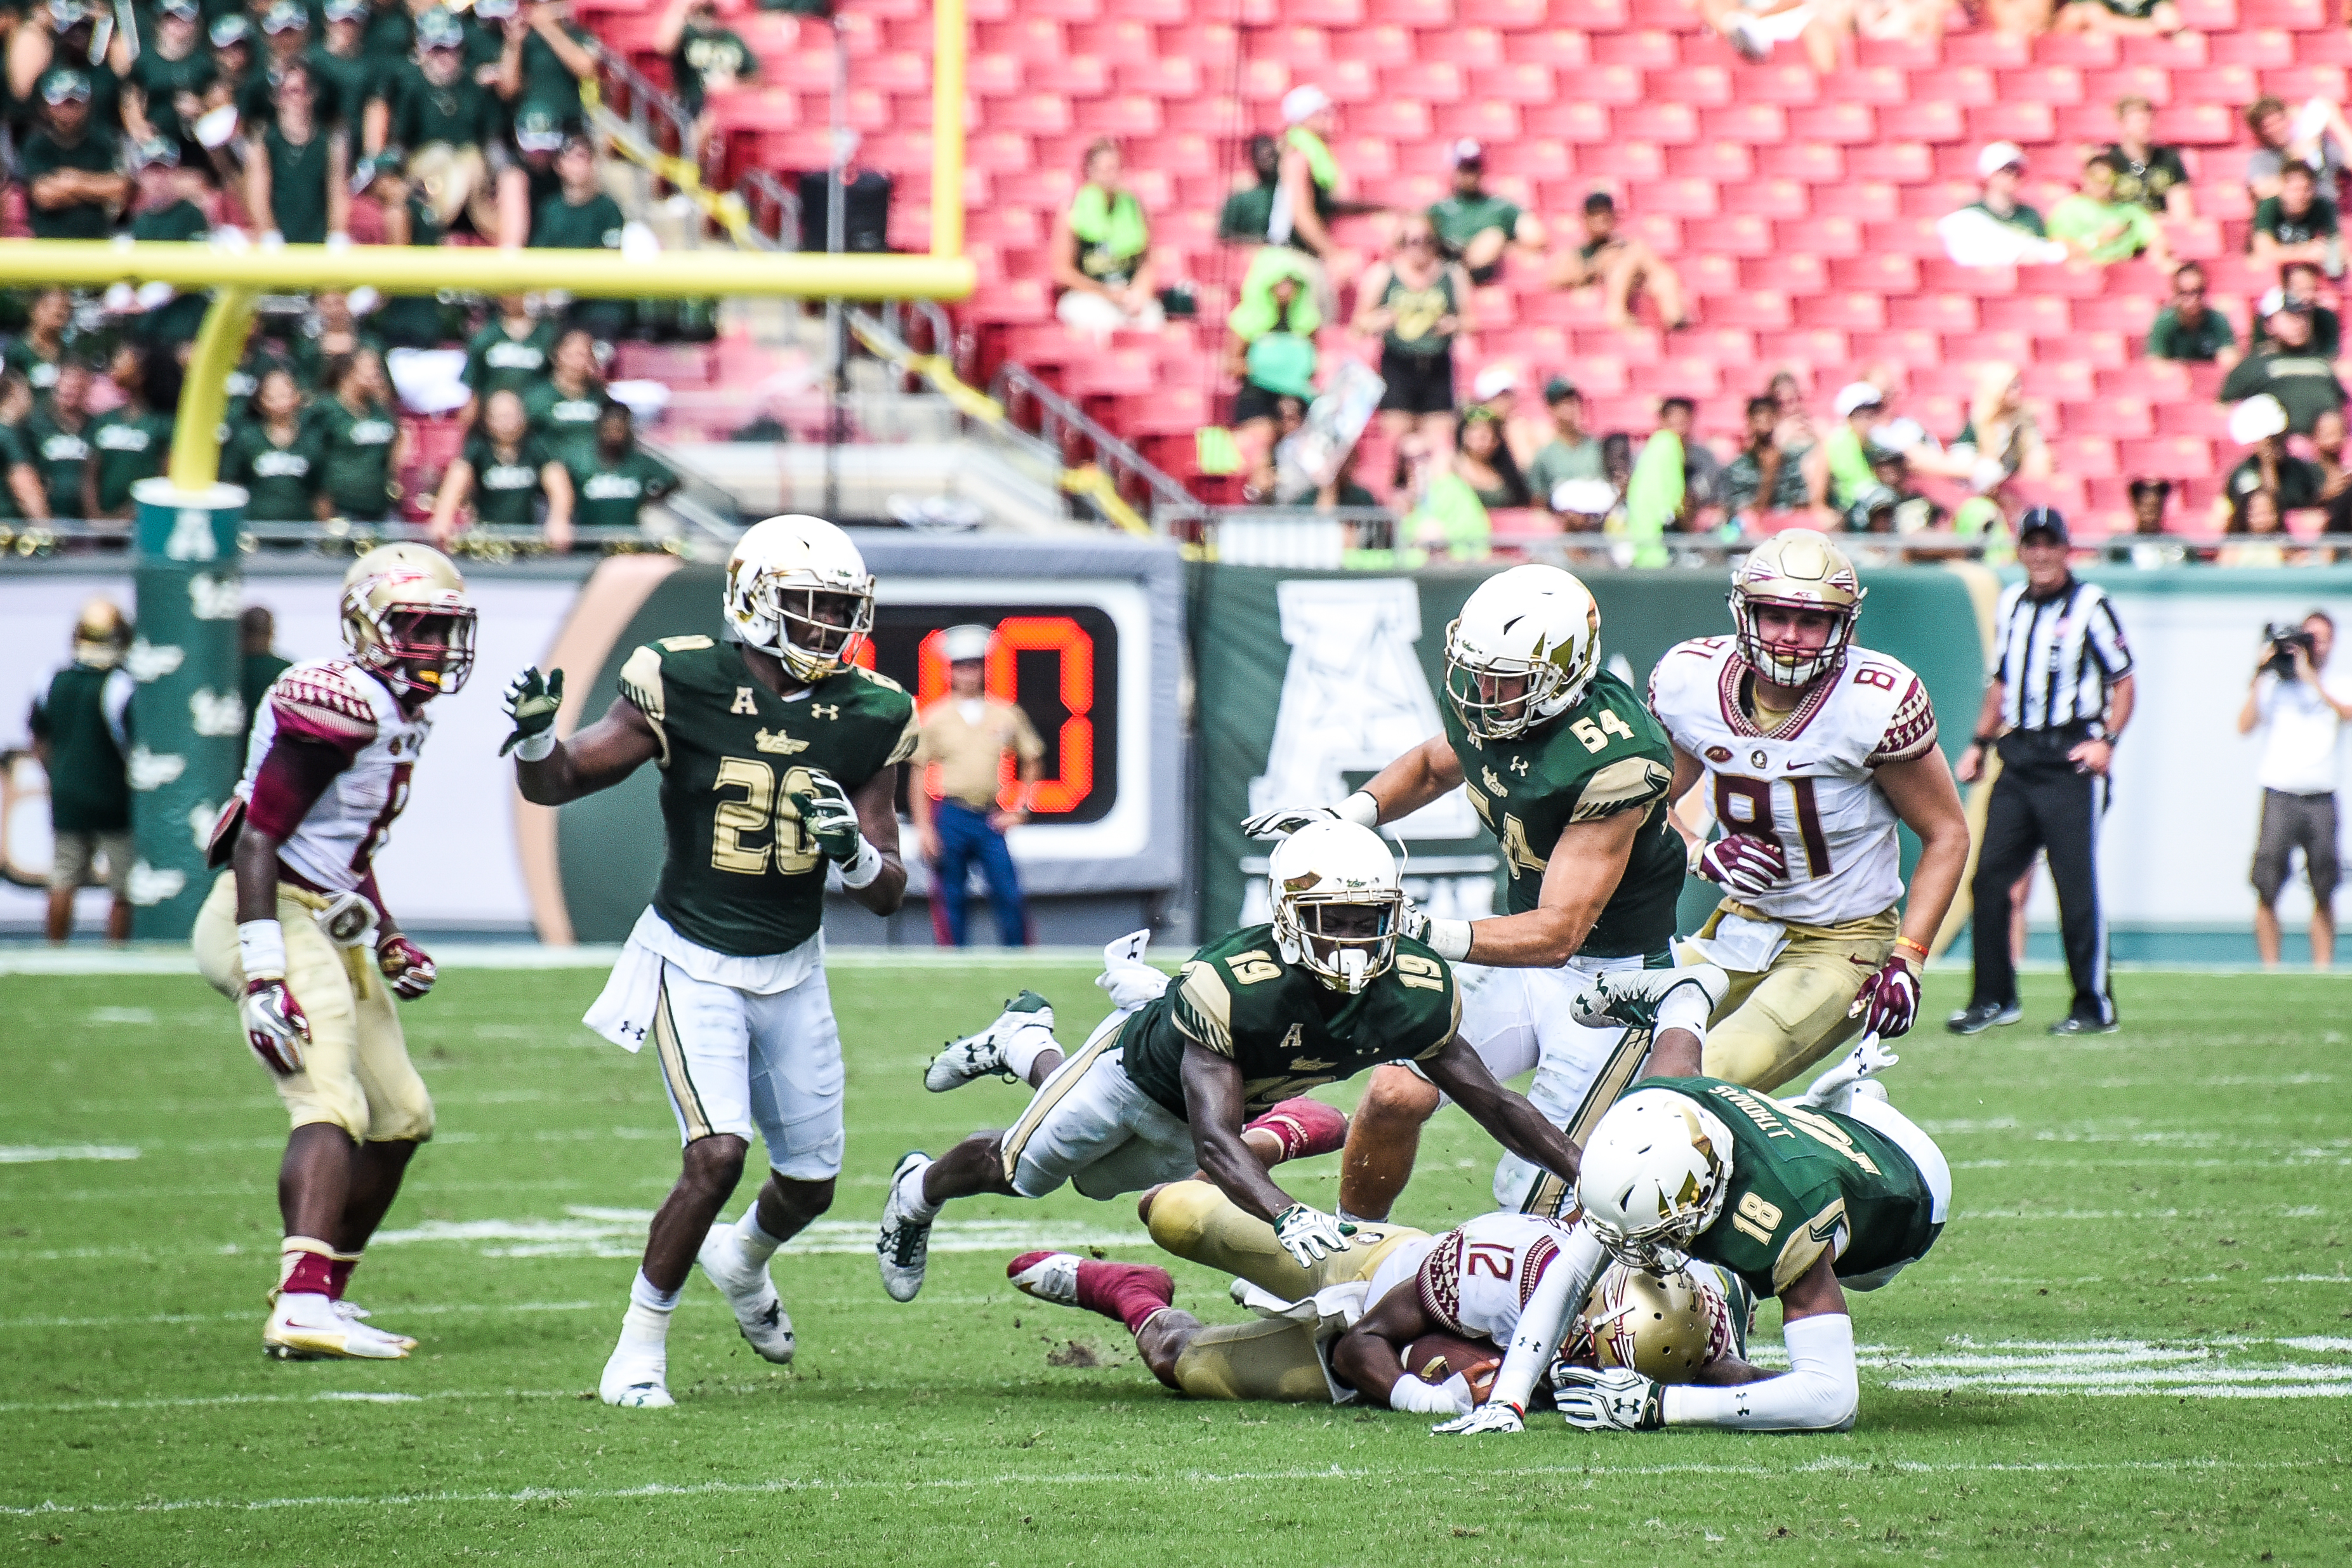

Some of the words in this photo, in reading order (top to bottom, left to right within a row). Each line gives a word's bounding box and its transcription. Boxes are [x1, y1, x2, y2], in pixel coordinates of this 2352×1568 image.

[1853, 661, 1901, 692] 81
[730, 686, 758, 715] A
[1249, 579, 1480, 840] A
[1569, 709, 1635, 754] 54
[1714, 772, 1833, 881] 81
[1225, 950, 1281, 985] 19
[1396, 954, 1443, 992] 19
[1280, 1023, 1304, 1047] A
[1733, 1191, 1783, 1246] 18
[1467, 1242, 1515, 1283] 12
